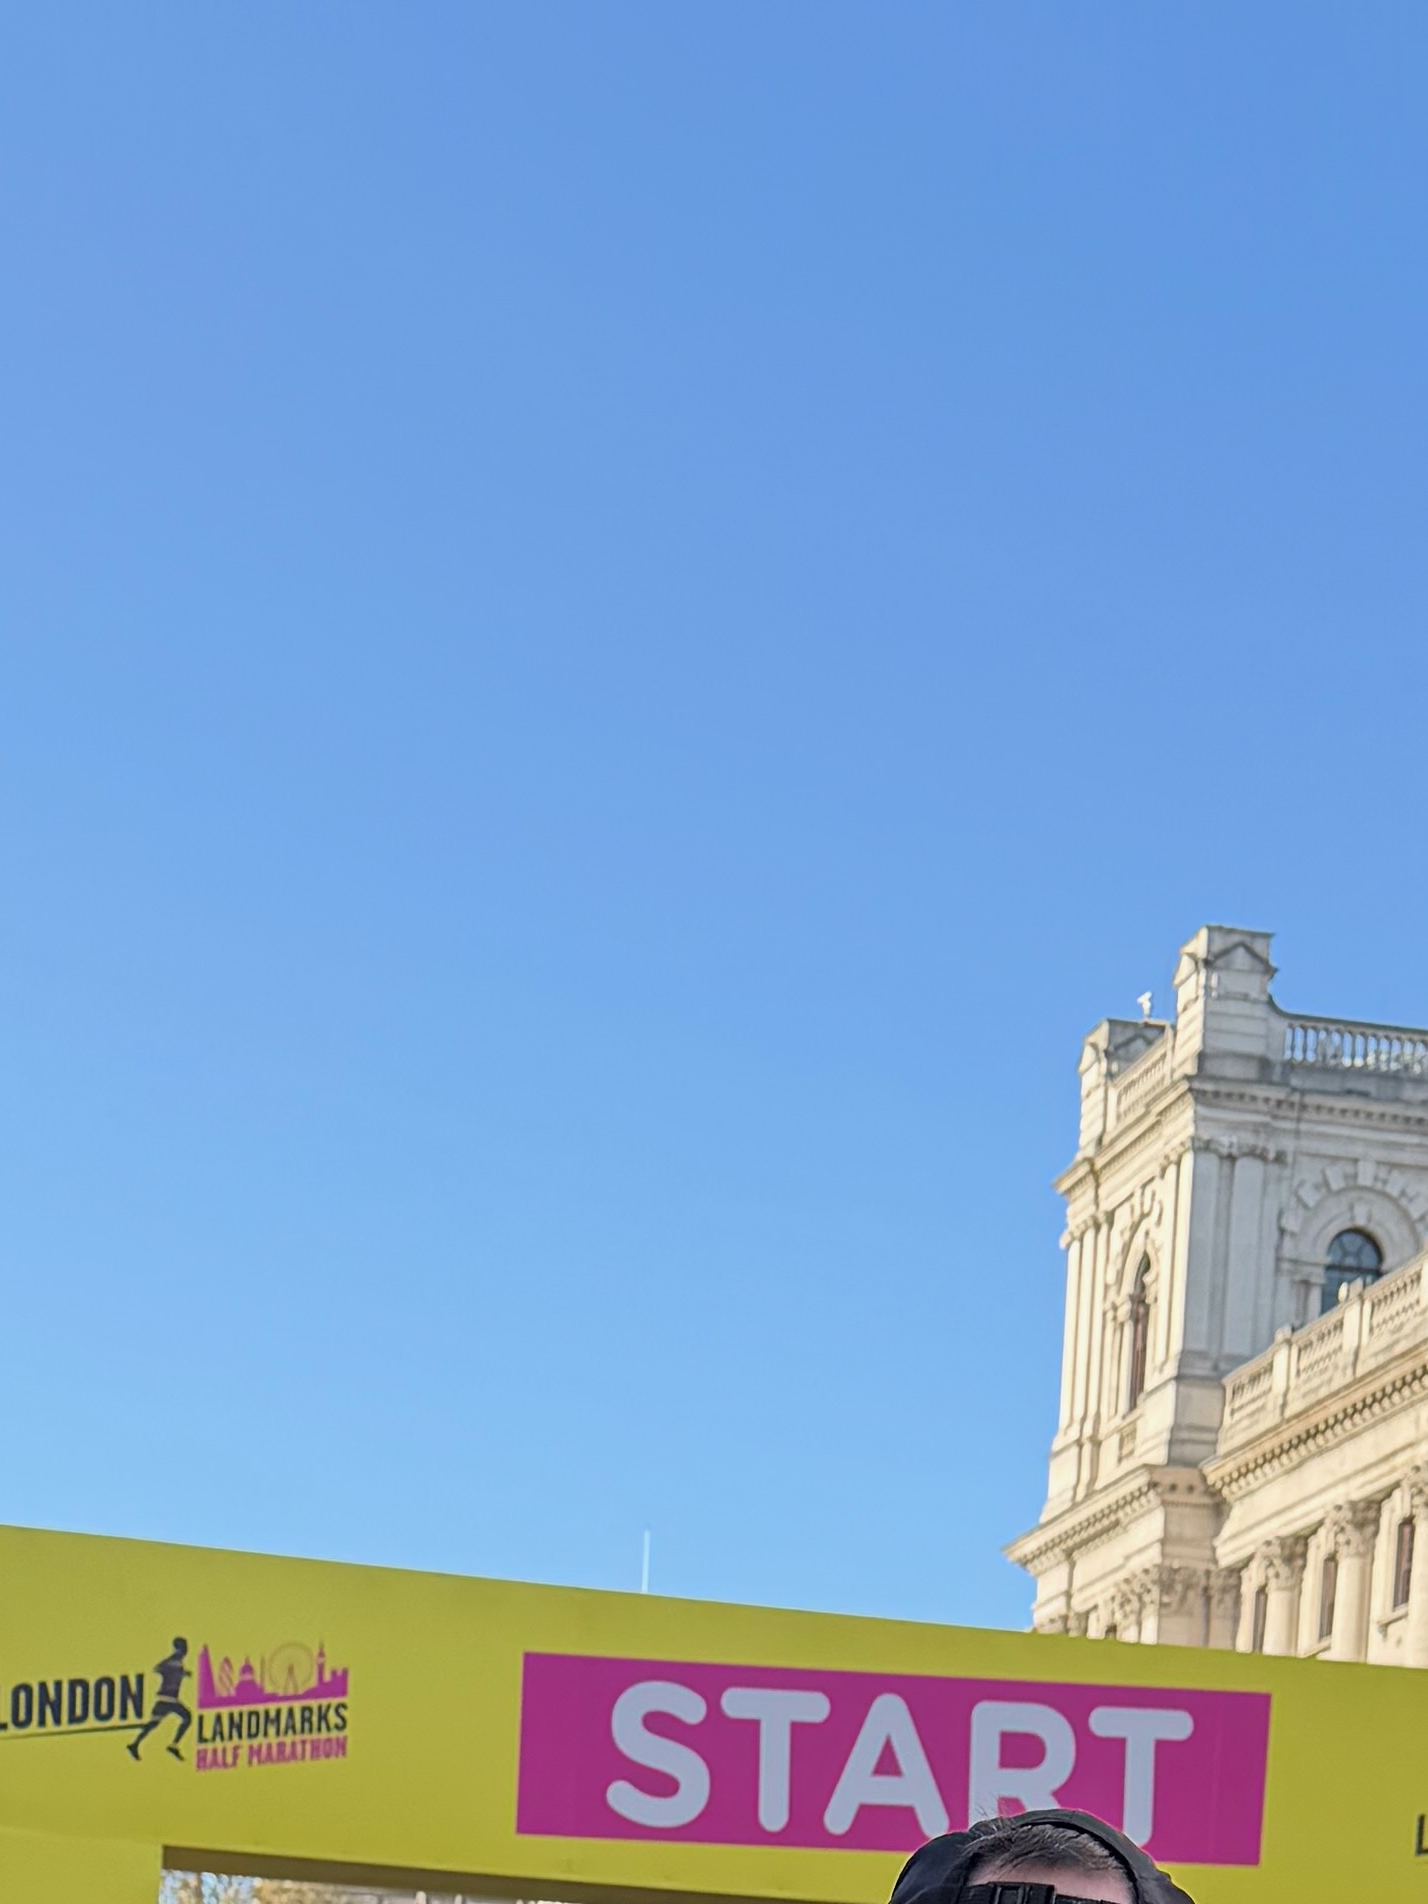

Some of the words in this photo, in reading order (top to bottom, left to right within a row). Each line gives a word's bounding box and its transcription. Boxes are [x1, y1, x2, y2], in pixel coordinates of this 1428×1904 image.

[196, 1702, 348, 1744] LANDMARKS
[195, 1744, 242, 1773] HALF
[247, 1735, 348, 1767] MARATHON
[606, 1680, 1194, 1846] START
